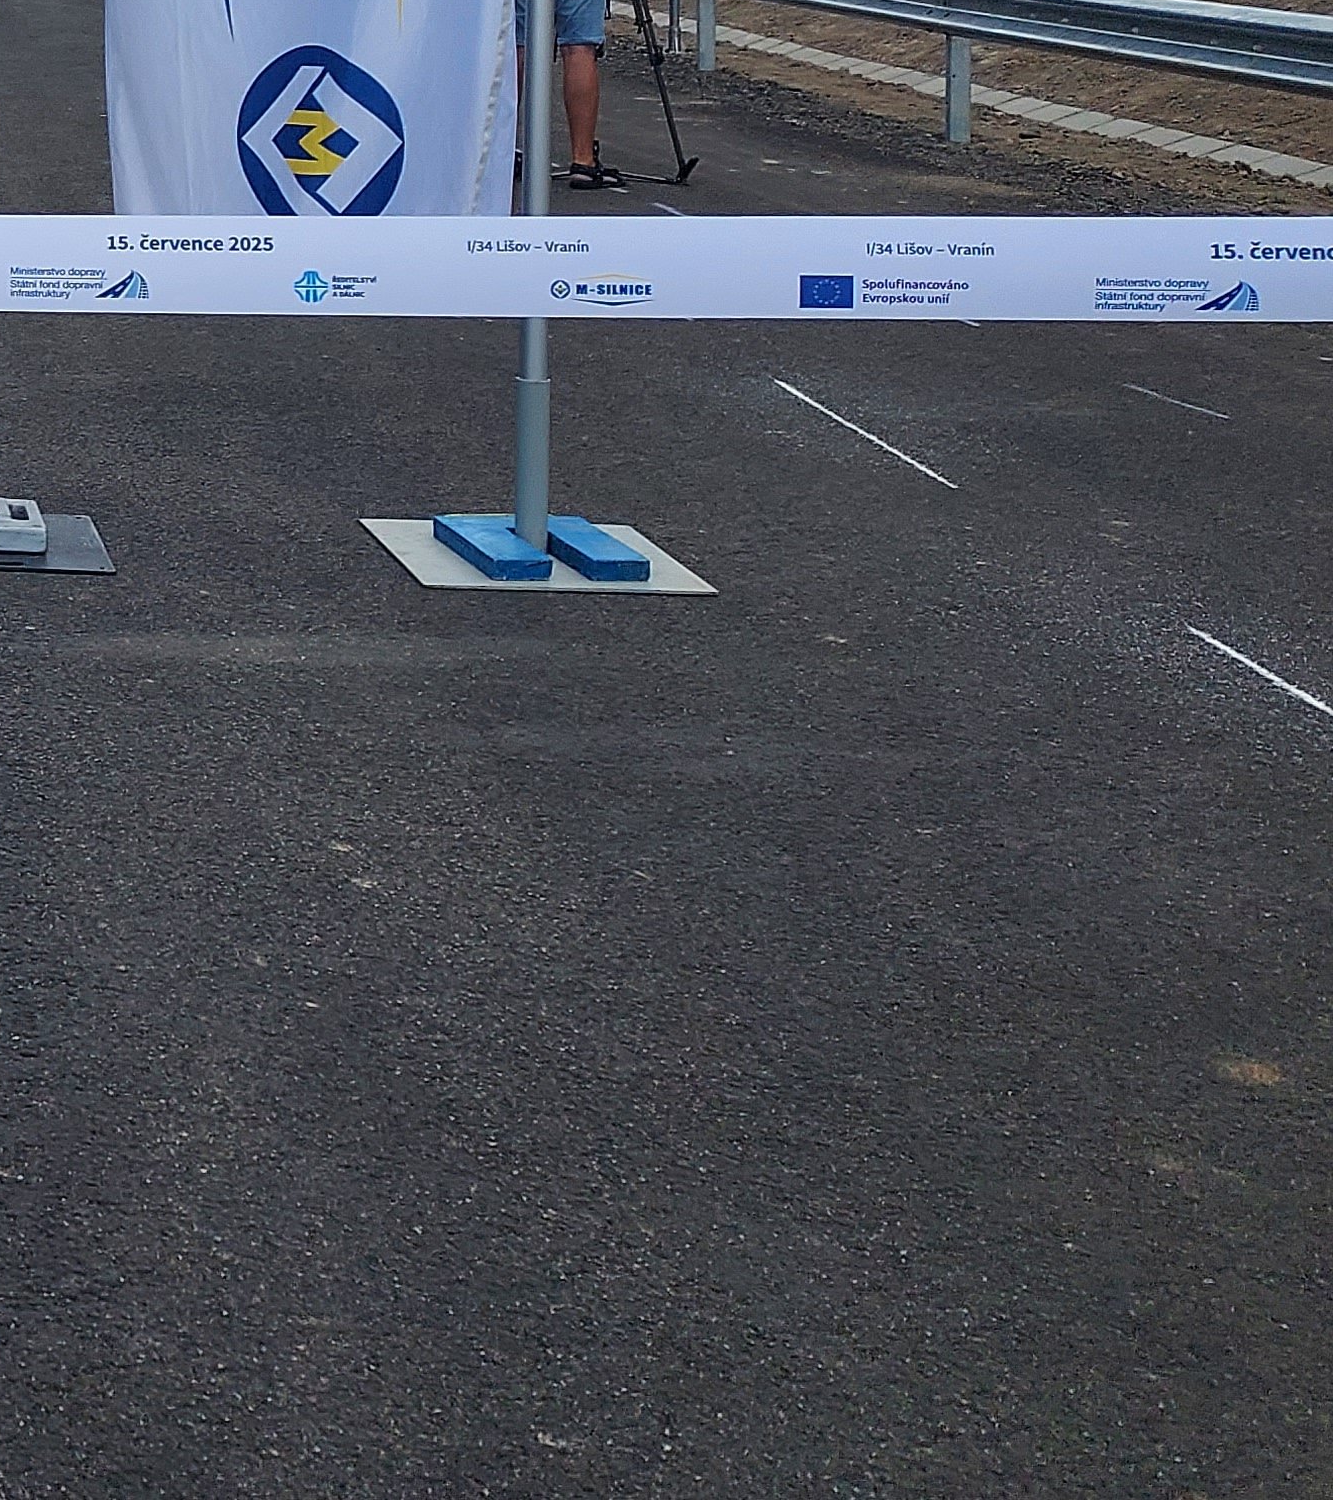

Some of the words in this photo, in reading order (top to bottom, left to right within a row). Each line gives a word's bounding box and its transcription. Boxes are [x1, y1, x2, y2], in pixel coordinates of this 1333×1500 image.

[107, 236, 134, 250] 15.
[140, 234, 223, 251] července
[228, 237, 274, 251] 2025
[467, 240, 493, 253] I/34
[496, 240, 531, 252] Lišov
[544, 240, 589, 252] Vranín
[866, 244, 893, 256] I/34
[897, 243, 933, 254] Lišov
[947, 243, 994, 255] Vranín
[1210, 244, 1243, 259] 15.
[10, 267, 66, 276] Ministerstvo
[68, 268, 105, 277] dopravy
[39, 280, 60, 289] fond
[862, 279, 969, 292] Spolufinancováno
[1095, 278, 1161, 287] Ministerstvo
[1164, 279, 1209, 289] dopravy
[10, 289, 71, 299] infrastruktury
[862, 293, 925, 305] Evropskou
[927, 293, 950, 304] unií
[1130, 291, 1154, 301] fond
[1157, 292, 1206, 302] dopravní
[1095, 301, 1166, 312] infrastruktury
